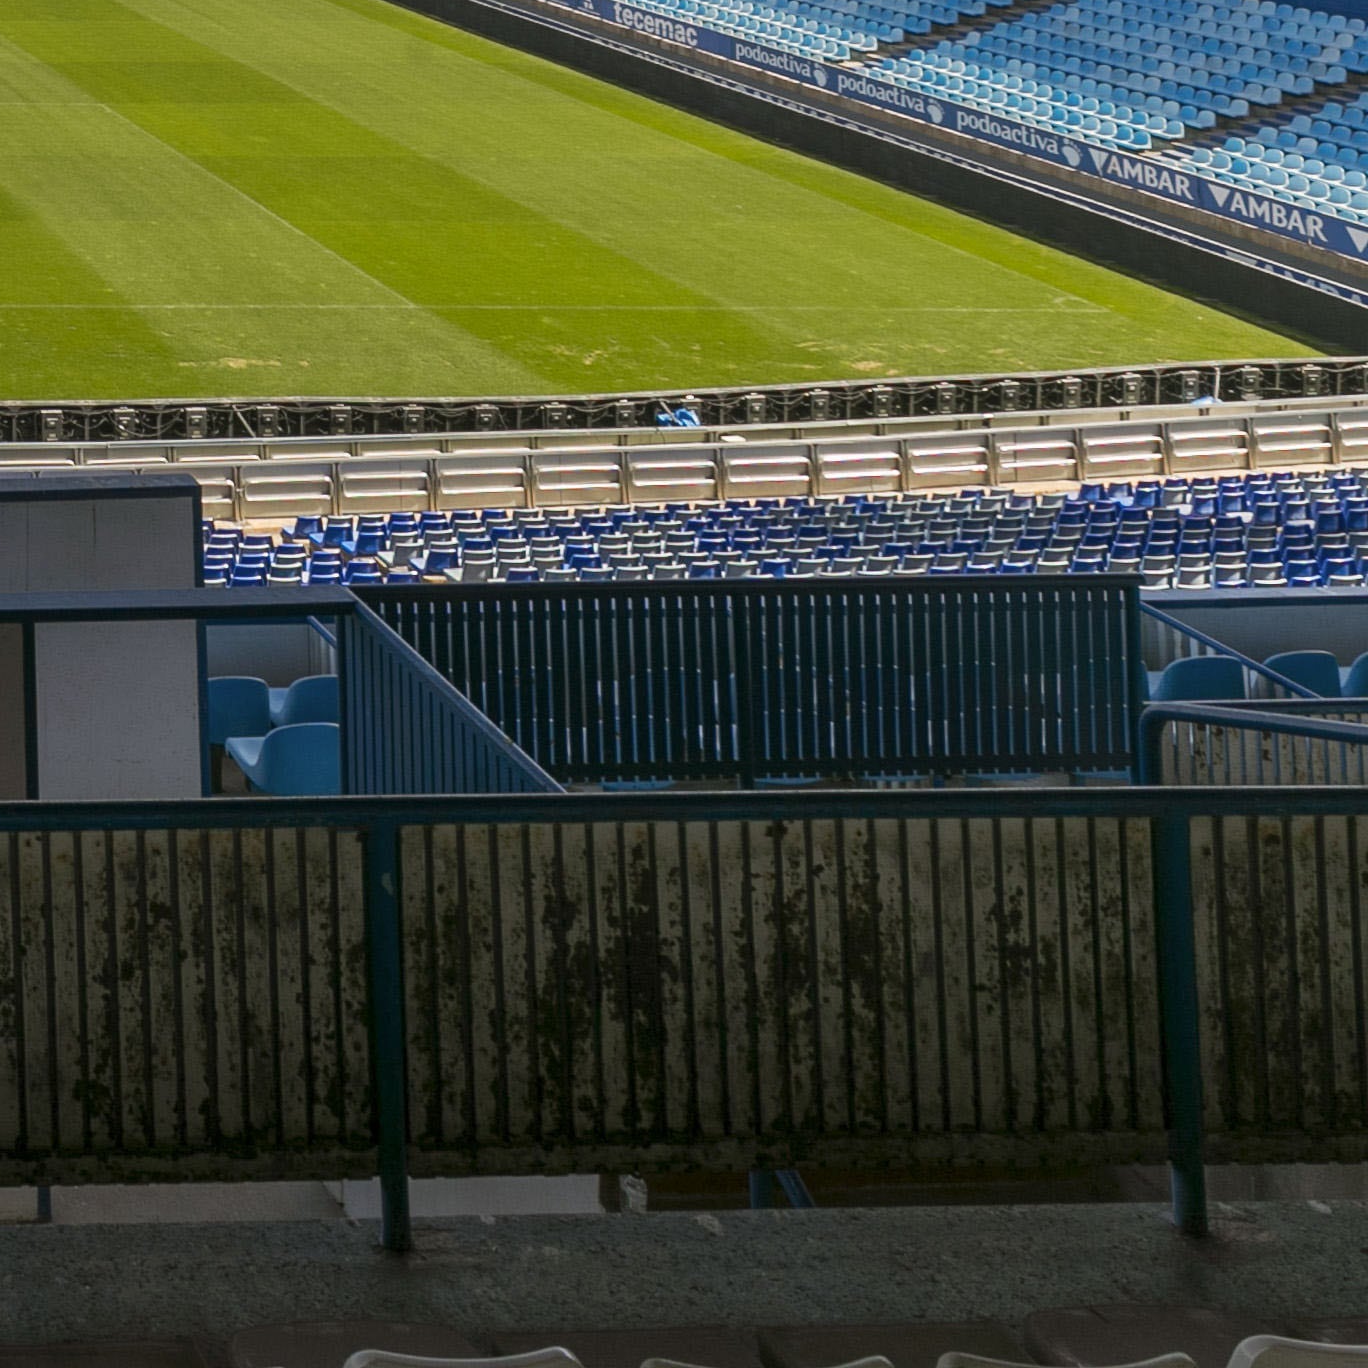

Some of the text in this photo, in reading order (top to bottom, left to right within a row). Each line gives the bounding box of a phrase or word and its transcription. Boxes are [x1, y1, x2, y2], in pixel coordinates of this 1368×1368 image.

[614, 2, 698, 47] tecemac
[735, 42, 811, 78] podoactiva
[837, 73, 925, 113] podoactiva
[956, 110, 1060, 155] podoactiva
[1106, 155, 1195, 201] AMBAR
[1229, 191, 1329, 243] AMBAR
